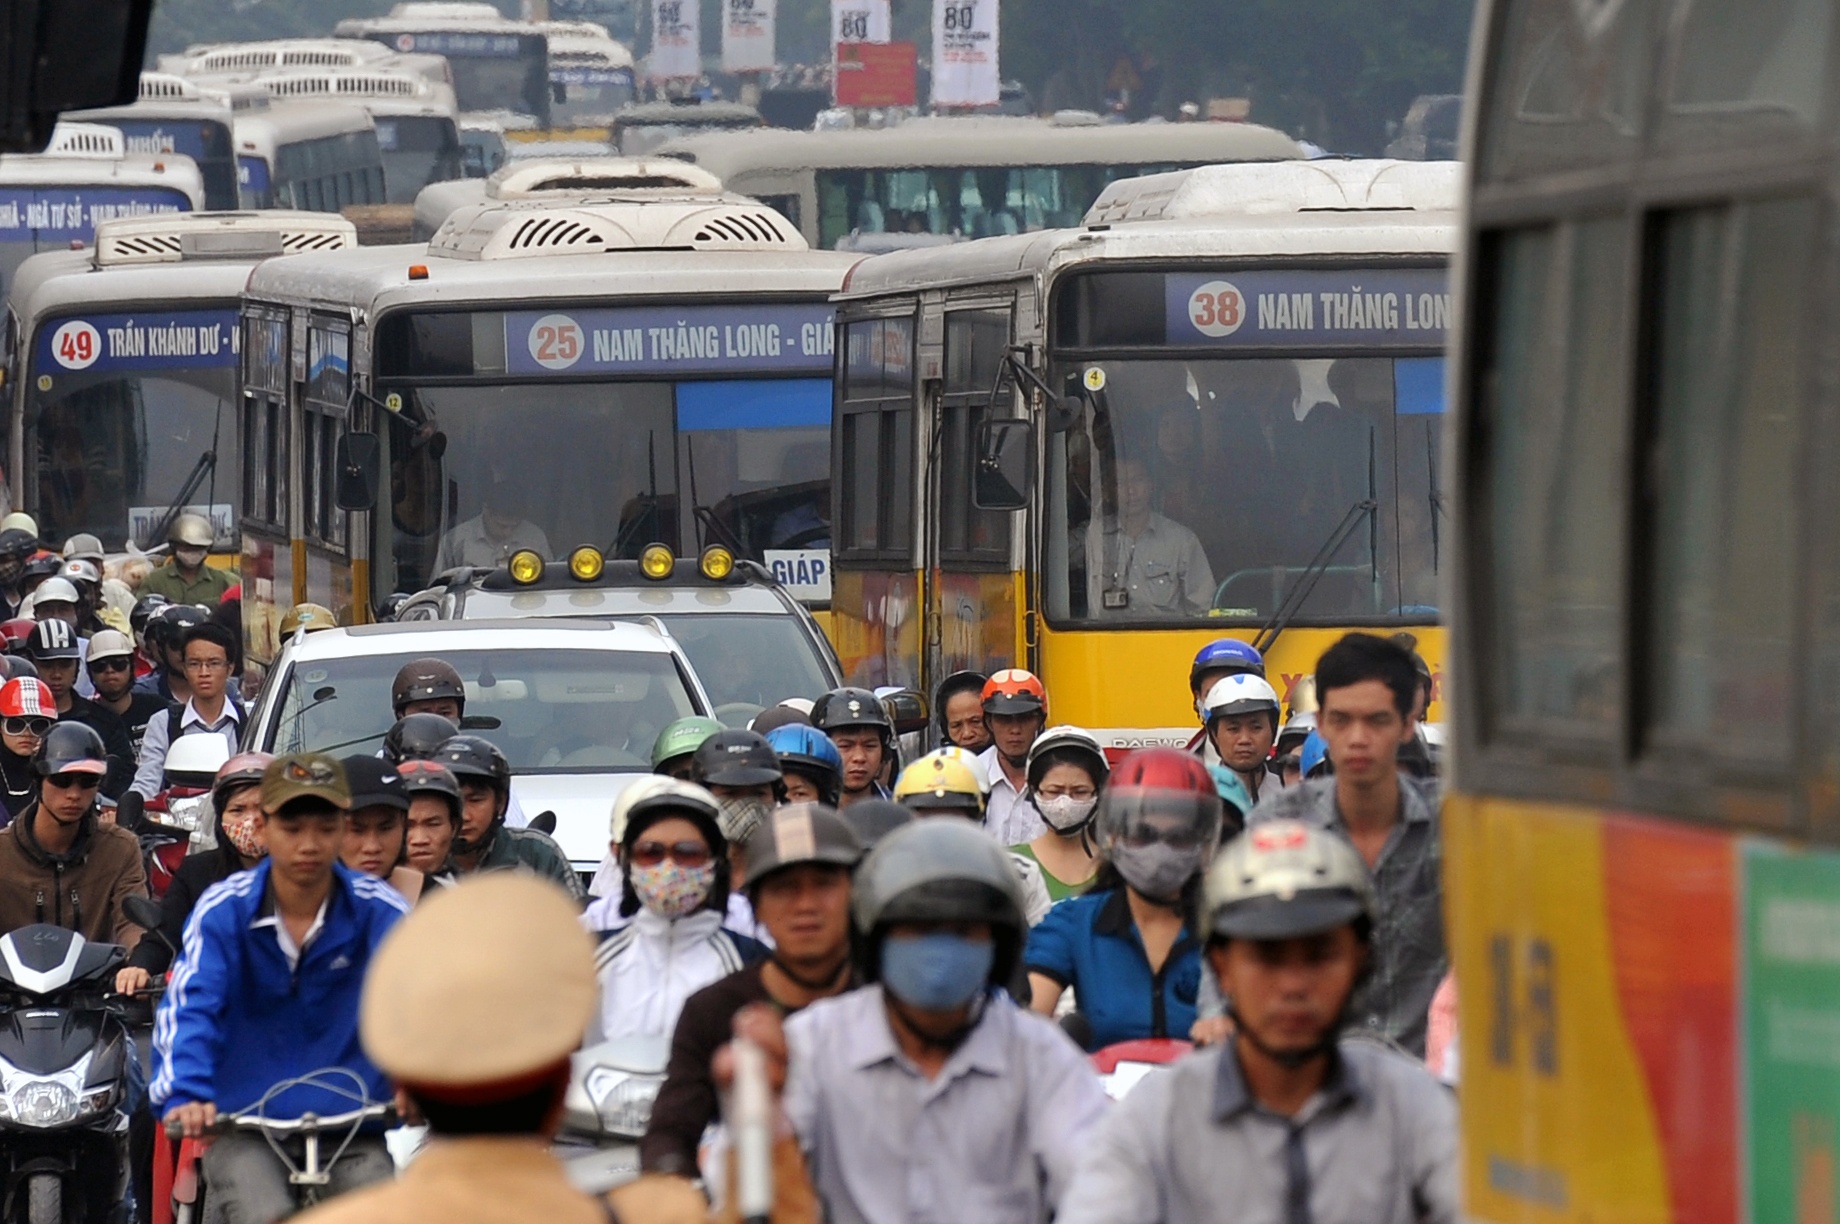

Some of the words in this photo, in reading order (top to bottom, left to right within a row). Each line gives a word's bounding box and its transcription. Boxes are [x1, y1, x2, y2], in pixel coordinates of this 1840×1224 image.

[945, 6, 973, 30] 80
[1195, 291, 1239, 326] 38
[1258, 294, 1314, 329] NAM
[1320, 285, 1399, 329] THĂNG
[60, 330, 92, 361] 49
[149, 321, 196, 356] KHÁNH
[200, 323, 221, 355] DƯ
[537, 325, 577, 360] 25
[593, 326, 644, 362] NAM
[649, 320, 718, 360] THĂNG
[725, 323, 781, 358] LONG
[772, 553, 825, 585] GIÁP
